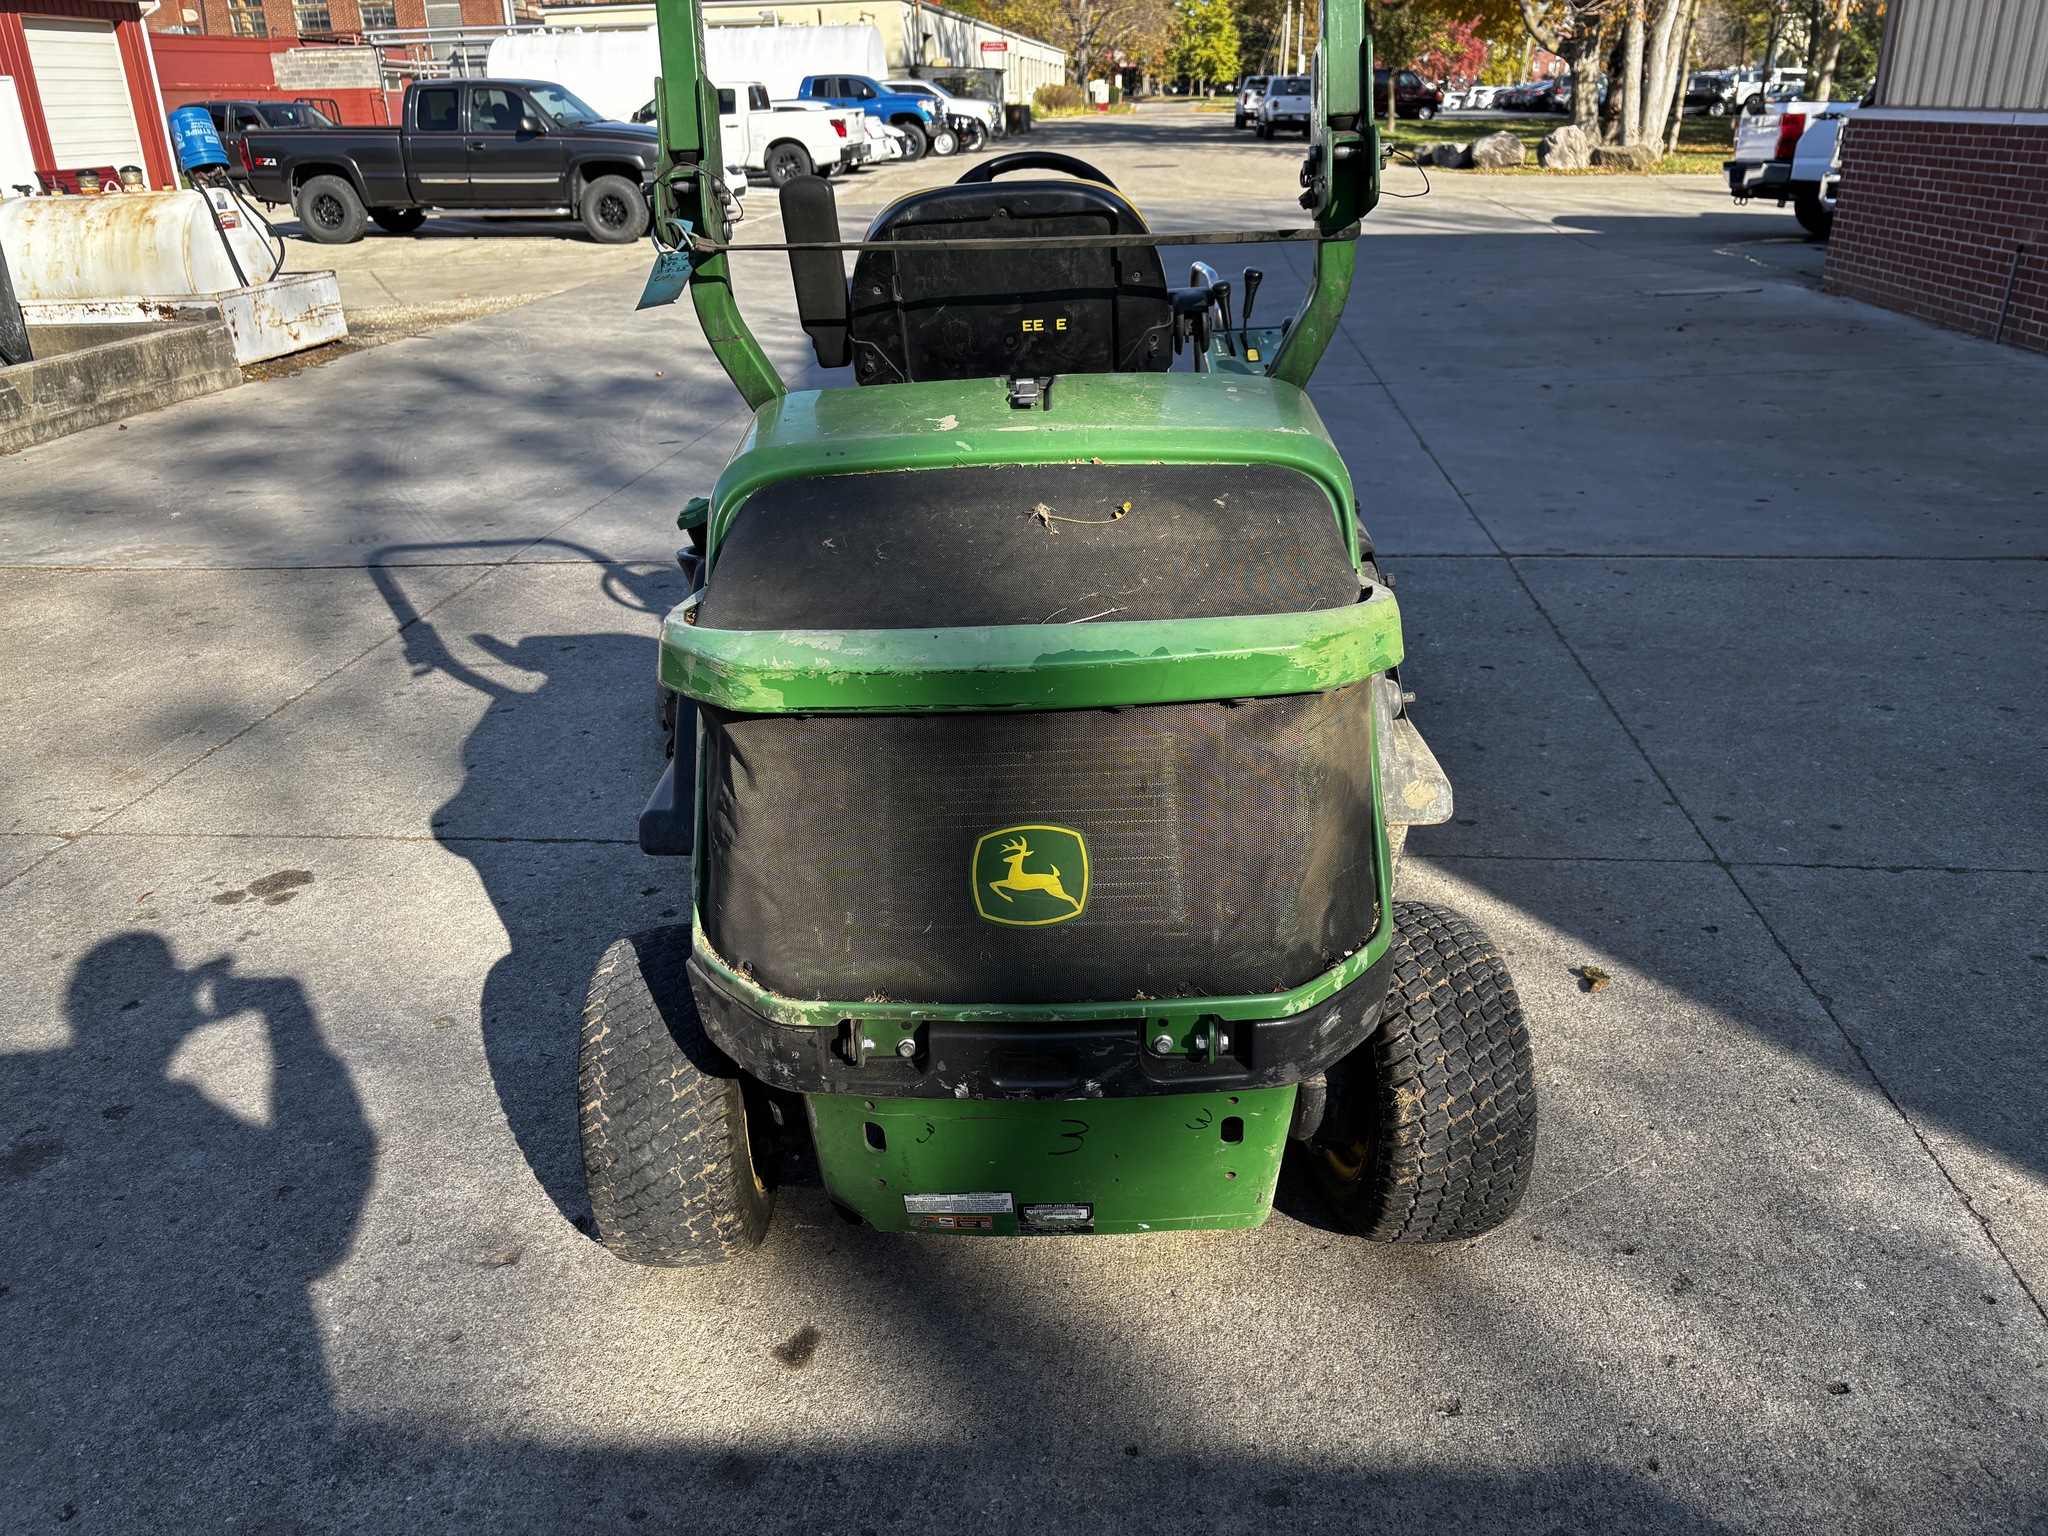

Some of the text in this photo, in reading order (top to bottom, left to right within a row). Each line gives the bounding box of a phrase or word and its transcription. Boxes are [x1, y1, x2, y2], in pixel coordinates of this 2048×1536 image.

[1812, 111, 1845, 120] 4X
[256, 158, 277, 166] Z71
[1185, 1107, 1213, 1130] 3
[1047, 1118, 1090, 1155] 3
